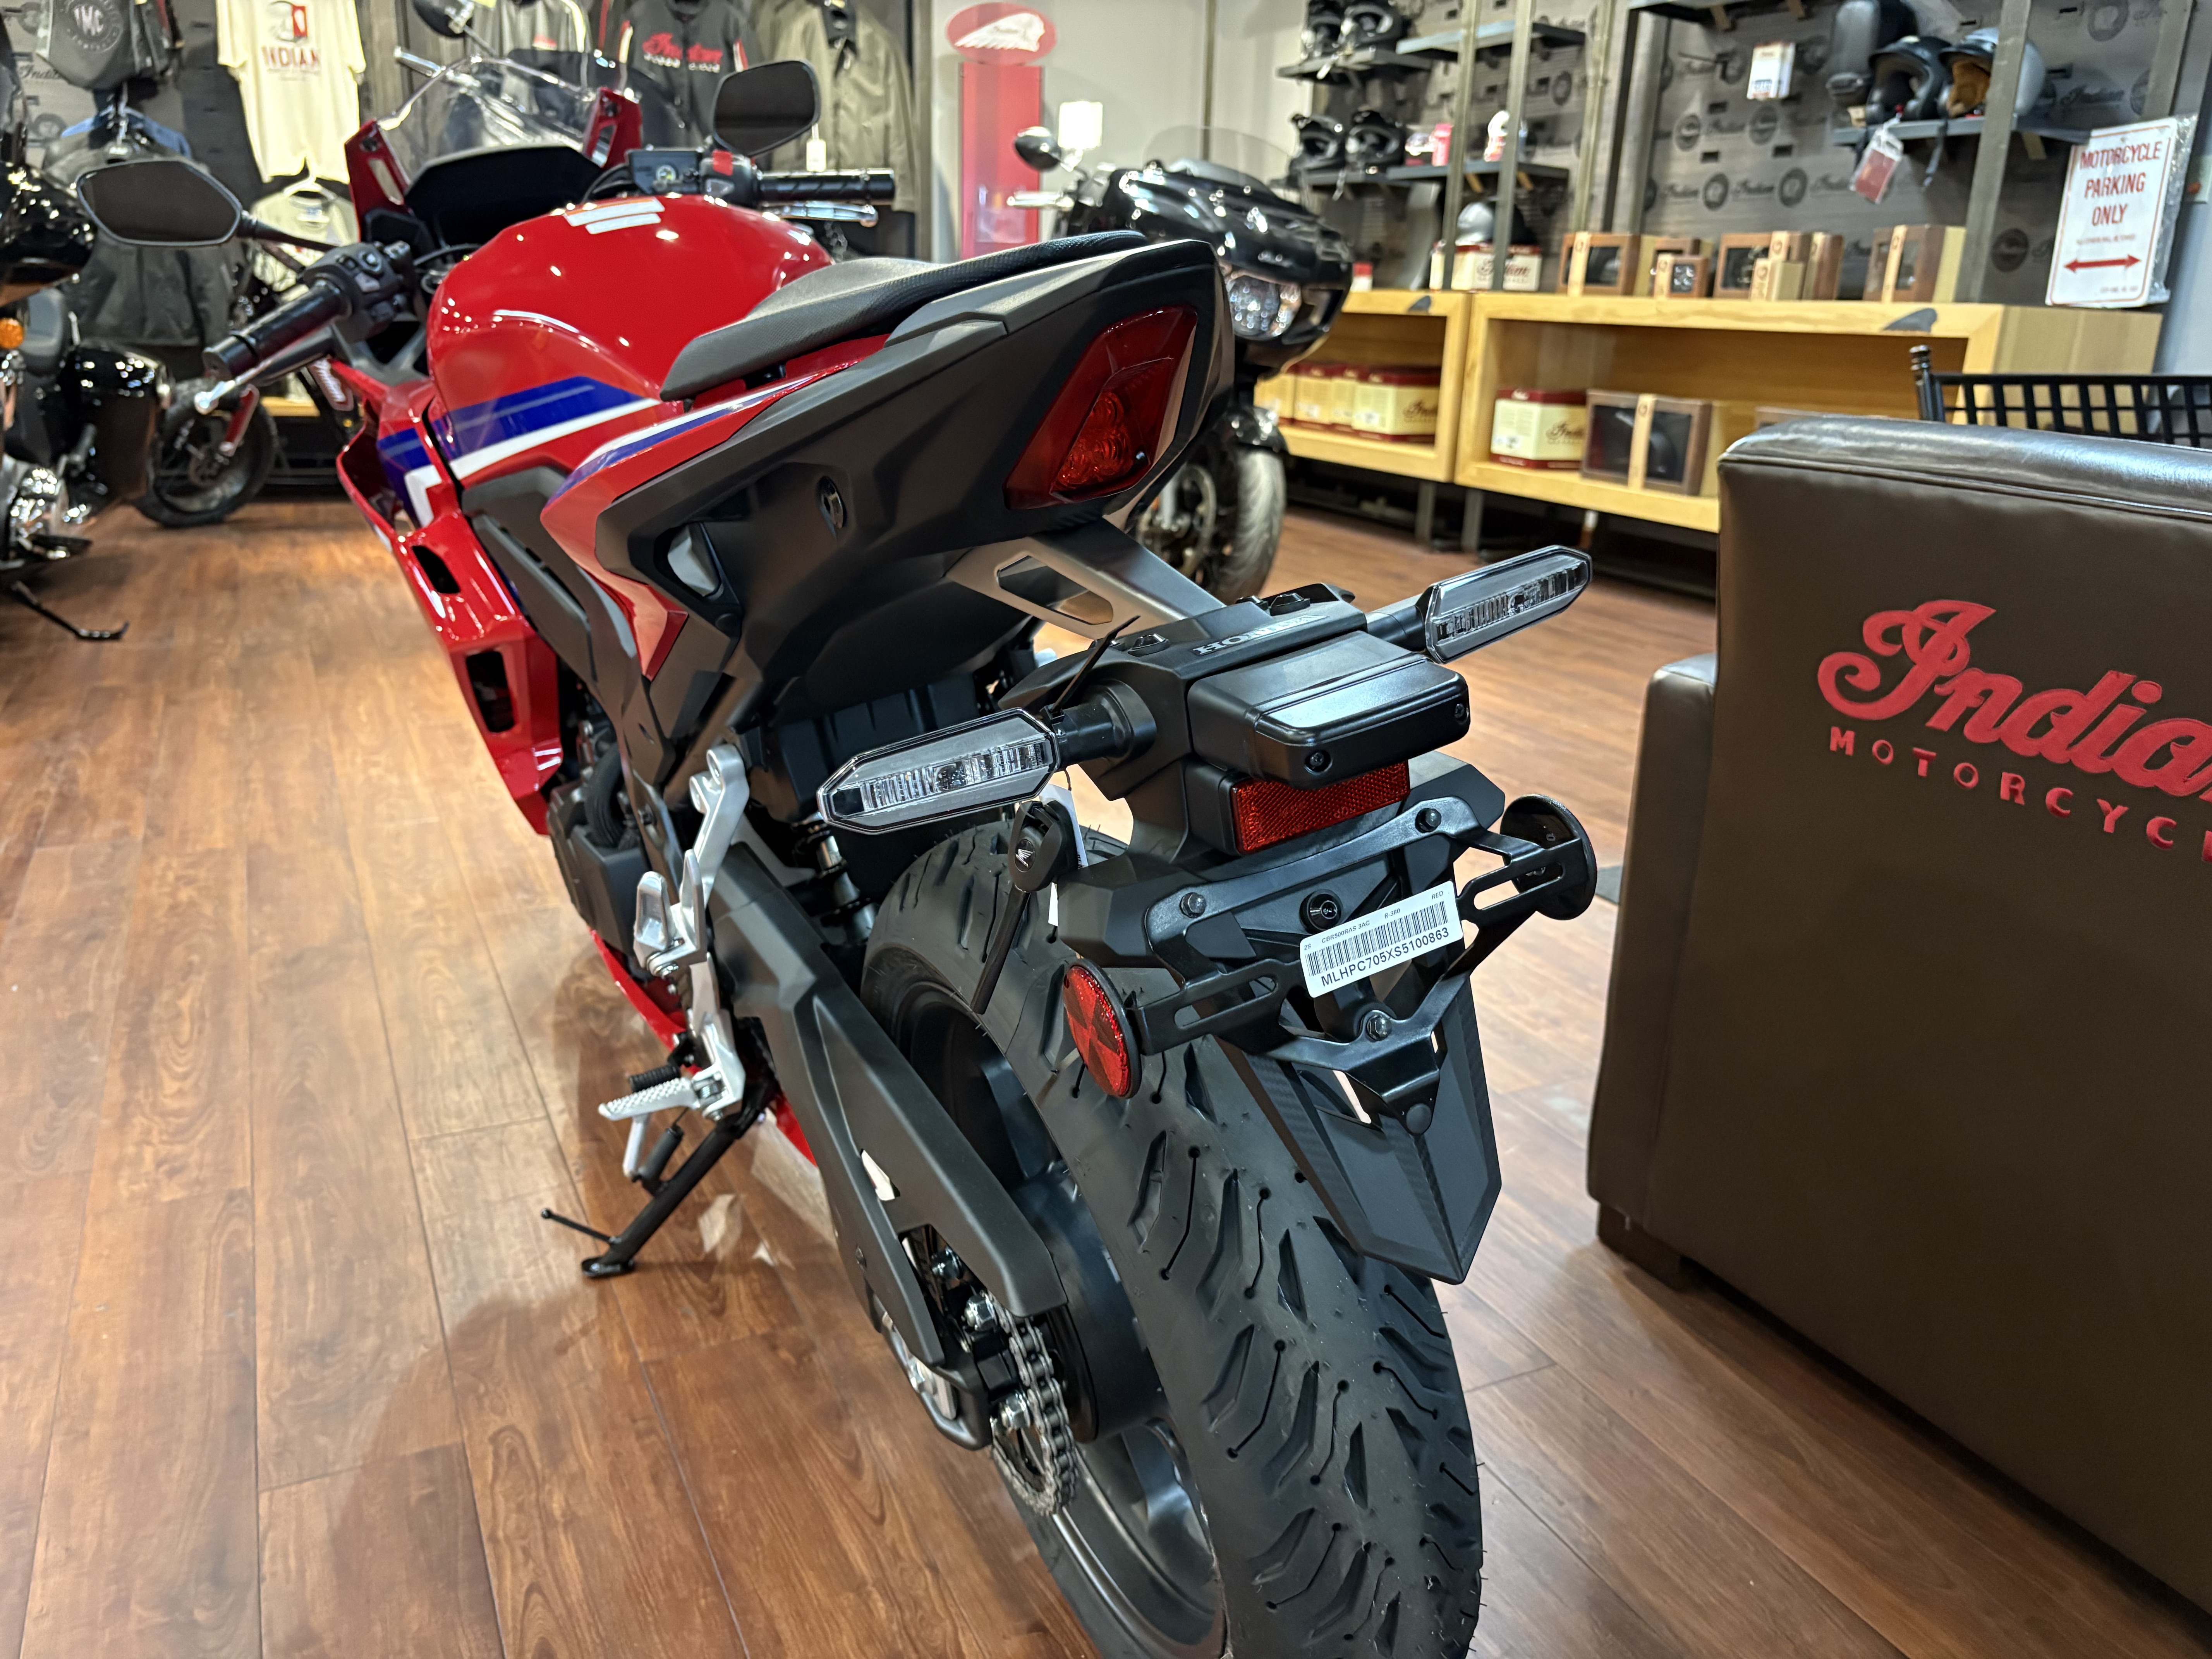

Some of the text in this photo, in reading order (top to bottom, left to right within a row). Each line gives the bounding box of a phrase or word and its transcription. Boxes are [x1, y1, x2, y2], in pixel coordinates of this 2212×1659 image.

[2080, 141, 2162, 170] MOTORCYCLE
[2084, 172, 2146, 199] PARKING
[2092, 204, 2128, 226] ONLY
[1193, 615, 1326, 654] HONDA
[1817, 599, 2212, 804] India
[1321, 926, 1357, 943] CBR500RAS
[1358, 920, 1370, 929] 3AC
[1384, 908, 1401, 919] R-380
[1431, 891, 1444, 900] RED
[1321, 927, 1449, 987] MLHPC705XS5100863
